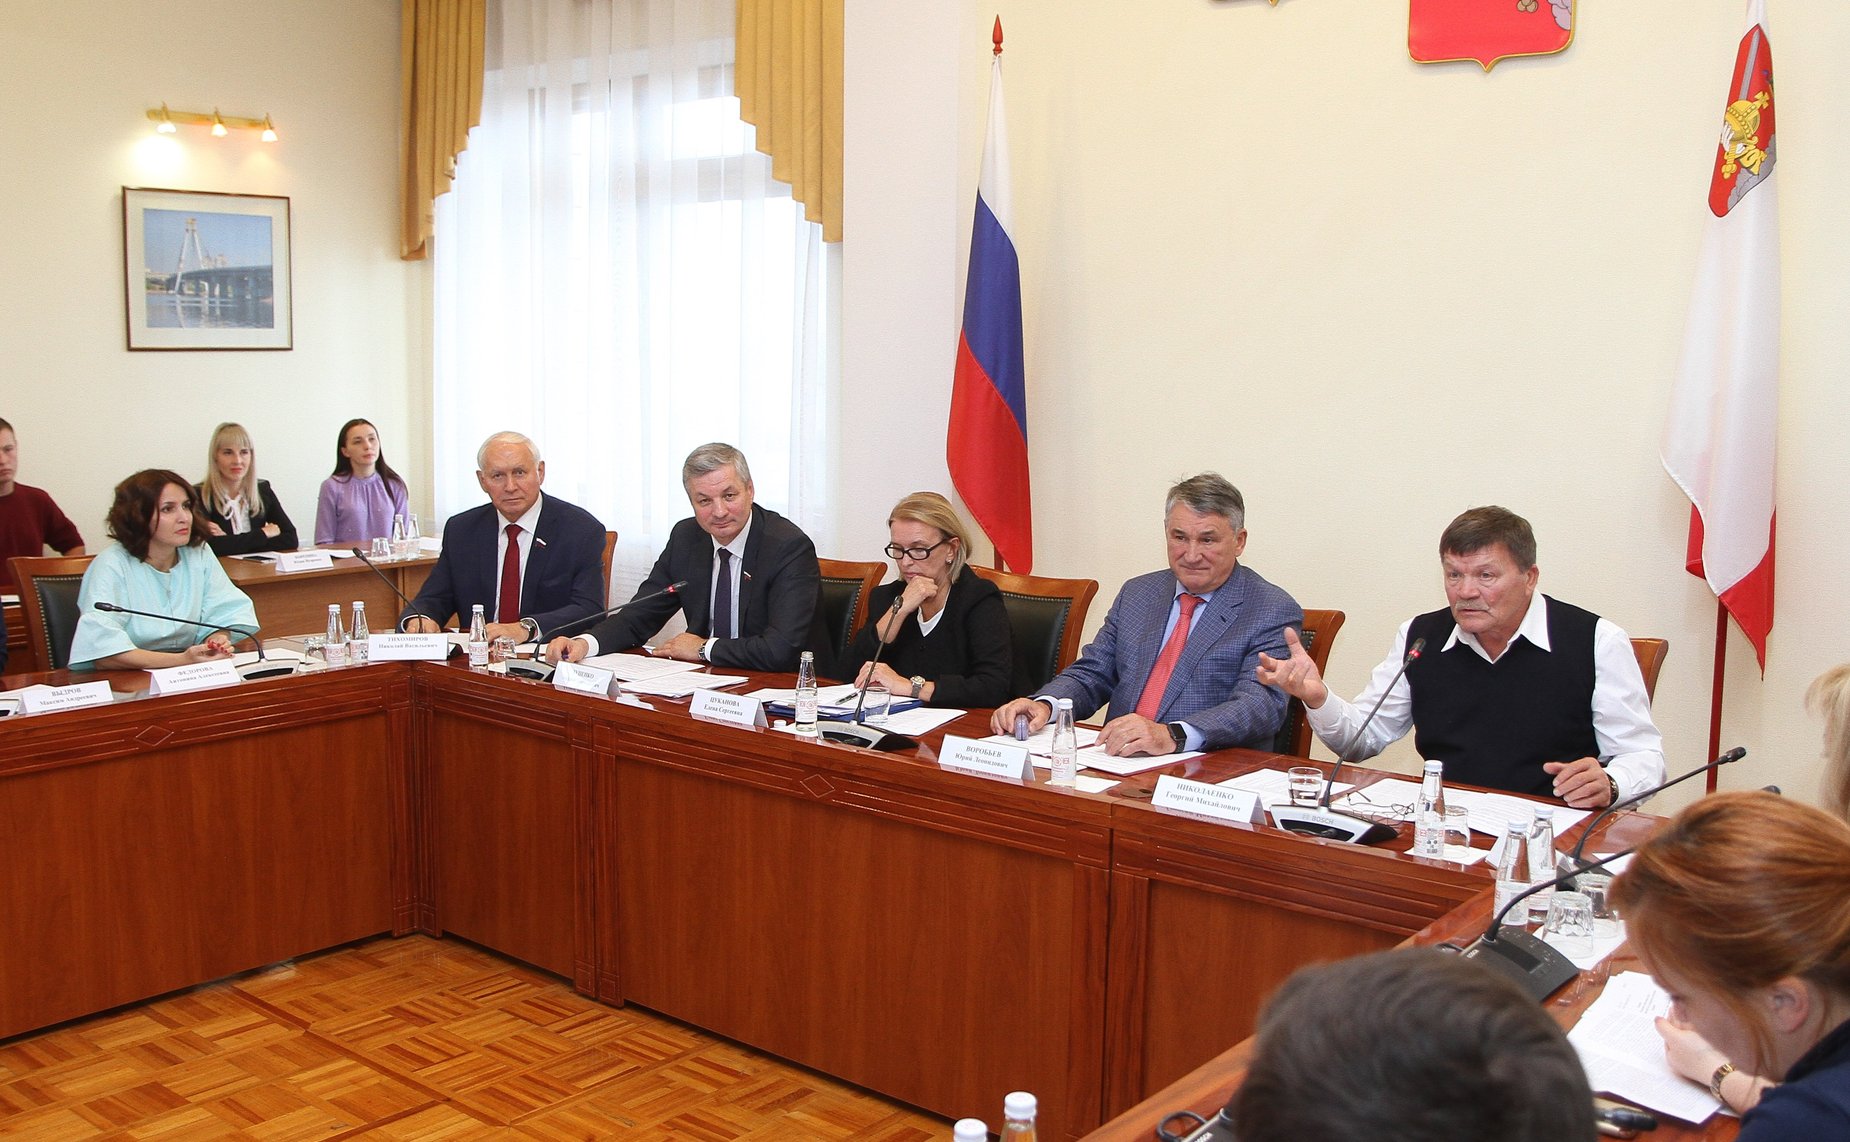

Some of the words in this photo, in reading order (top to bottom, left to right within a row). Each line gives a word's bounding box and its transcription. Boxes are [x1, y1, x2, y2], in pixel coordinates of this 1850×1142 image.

[709, 696, 740, 707] ЦУКАНОВА
[703, 703, 718, 712] Елена
[718, 706, 743, 717] Сергеевна
[966, 745, 1002, 758] ВОРОБЬЕВ
[954, 752, 973, 764] Юрий
[973, 755, 1009, 770] Леонидович
[1176, 782, 1235, 801] НИКОЛАЕНКО
[1165, 790, 1195, 803] Георгий
[1195, 796, 1242, 813] Михайлович
[1311, 815, 1335, 825] BOSCH
